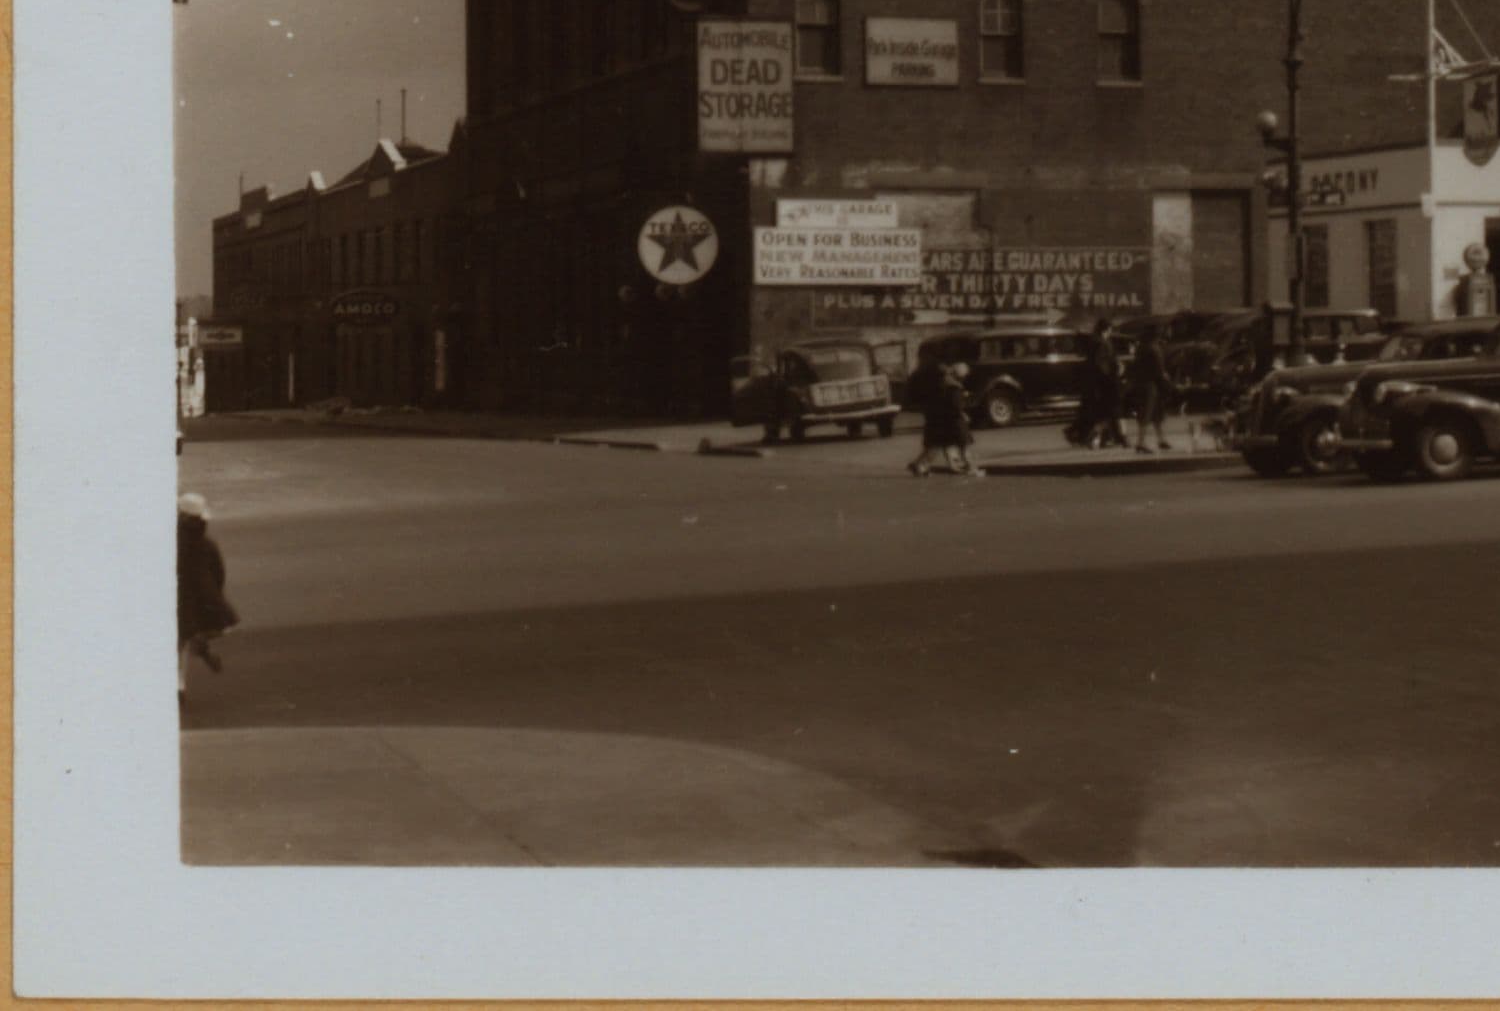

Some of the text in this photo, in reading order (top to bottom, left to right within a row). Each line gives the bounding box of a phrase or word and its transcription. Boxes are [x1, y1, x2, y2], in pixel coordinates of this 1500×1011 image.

[710, 58, 782, 86] DEAD
[699, 91, 793, 118] STORAGE
[761, 231, 918, 247] OPEN FOR BUSINESS
[759, 264, 792, 278] VERY
[1033, 273, 1094, 294] DAYS
[333, 302, 396, 316] AMOCO
[823, 293, 876, 309] PLUS
[880, 294, 896, 309] A
[899, 293, 965, 309] SEVEN
[1013, 293, 1072, 309] FREE
[1080, 292, 1145, 308] TRIAL
